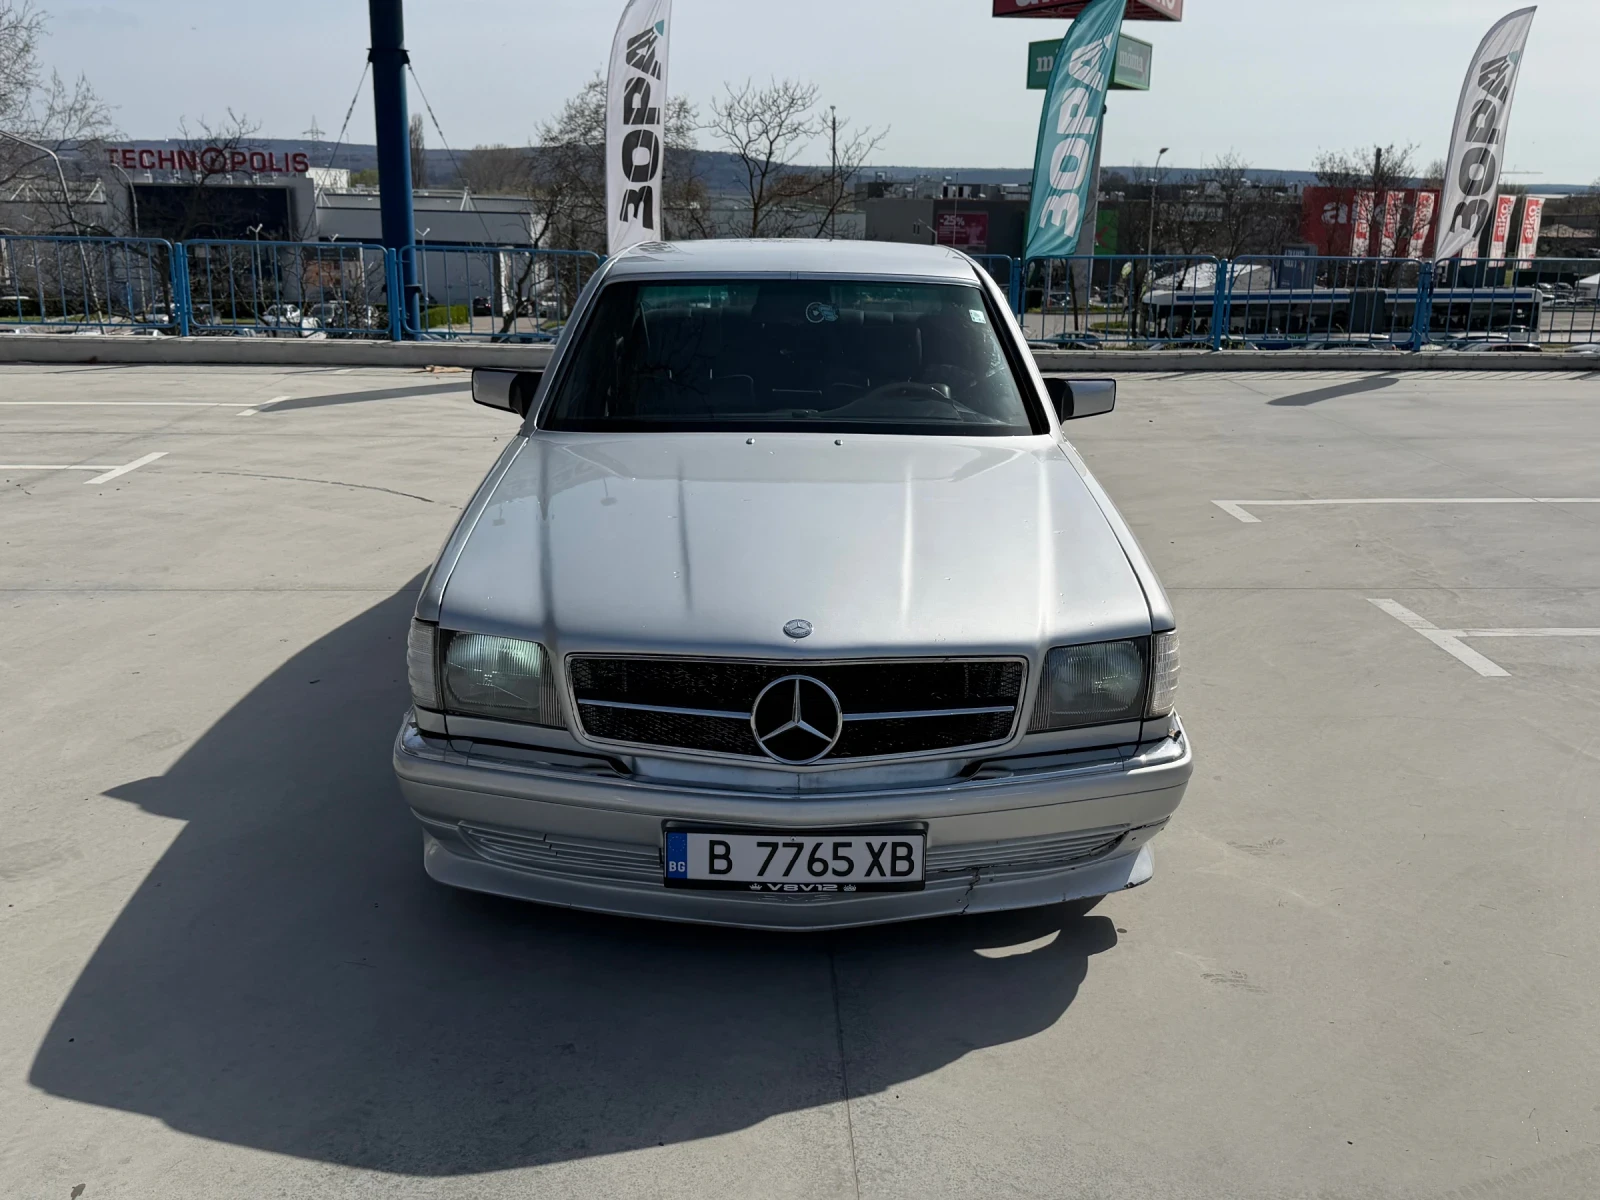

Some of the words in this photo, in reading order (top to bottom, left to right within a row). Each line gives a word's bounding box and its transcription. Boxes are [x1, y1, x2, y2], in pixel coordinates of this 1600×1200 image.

[107, 147, 309, 173] TECHNOPOLIS
[939, 215, 965, 226] -25%
[1496, 203, 1509, 236] aiko
[1523, 205, 1538, 238] aiko
[668, 861, 686, 873] BG
[708, 840, 733, 875] B
[756, 841, 855, 877] 7765
[864, 841, 915, 877] XB
[767, 883, 838, 892] V8V12
